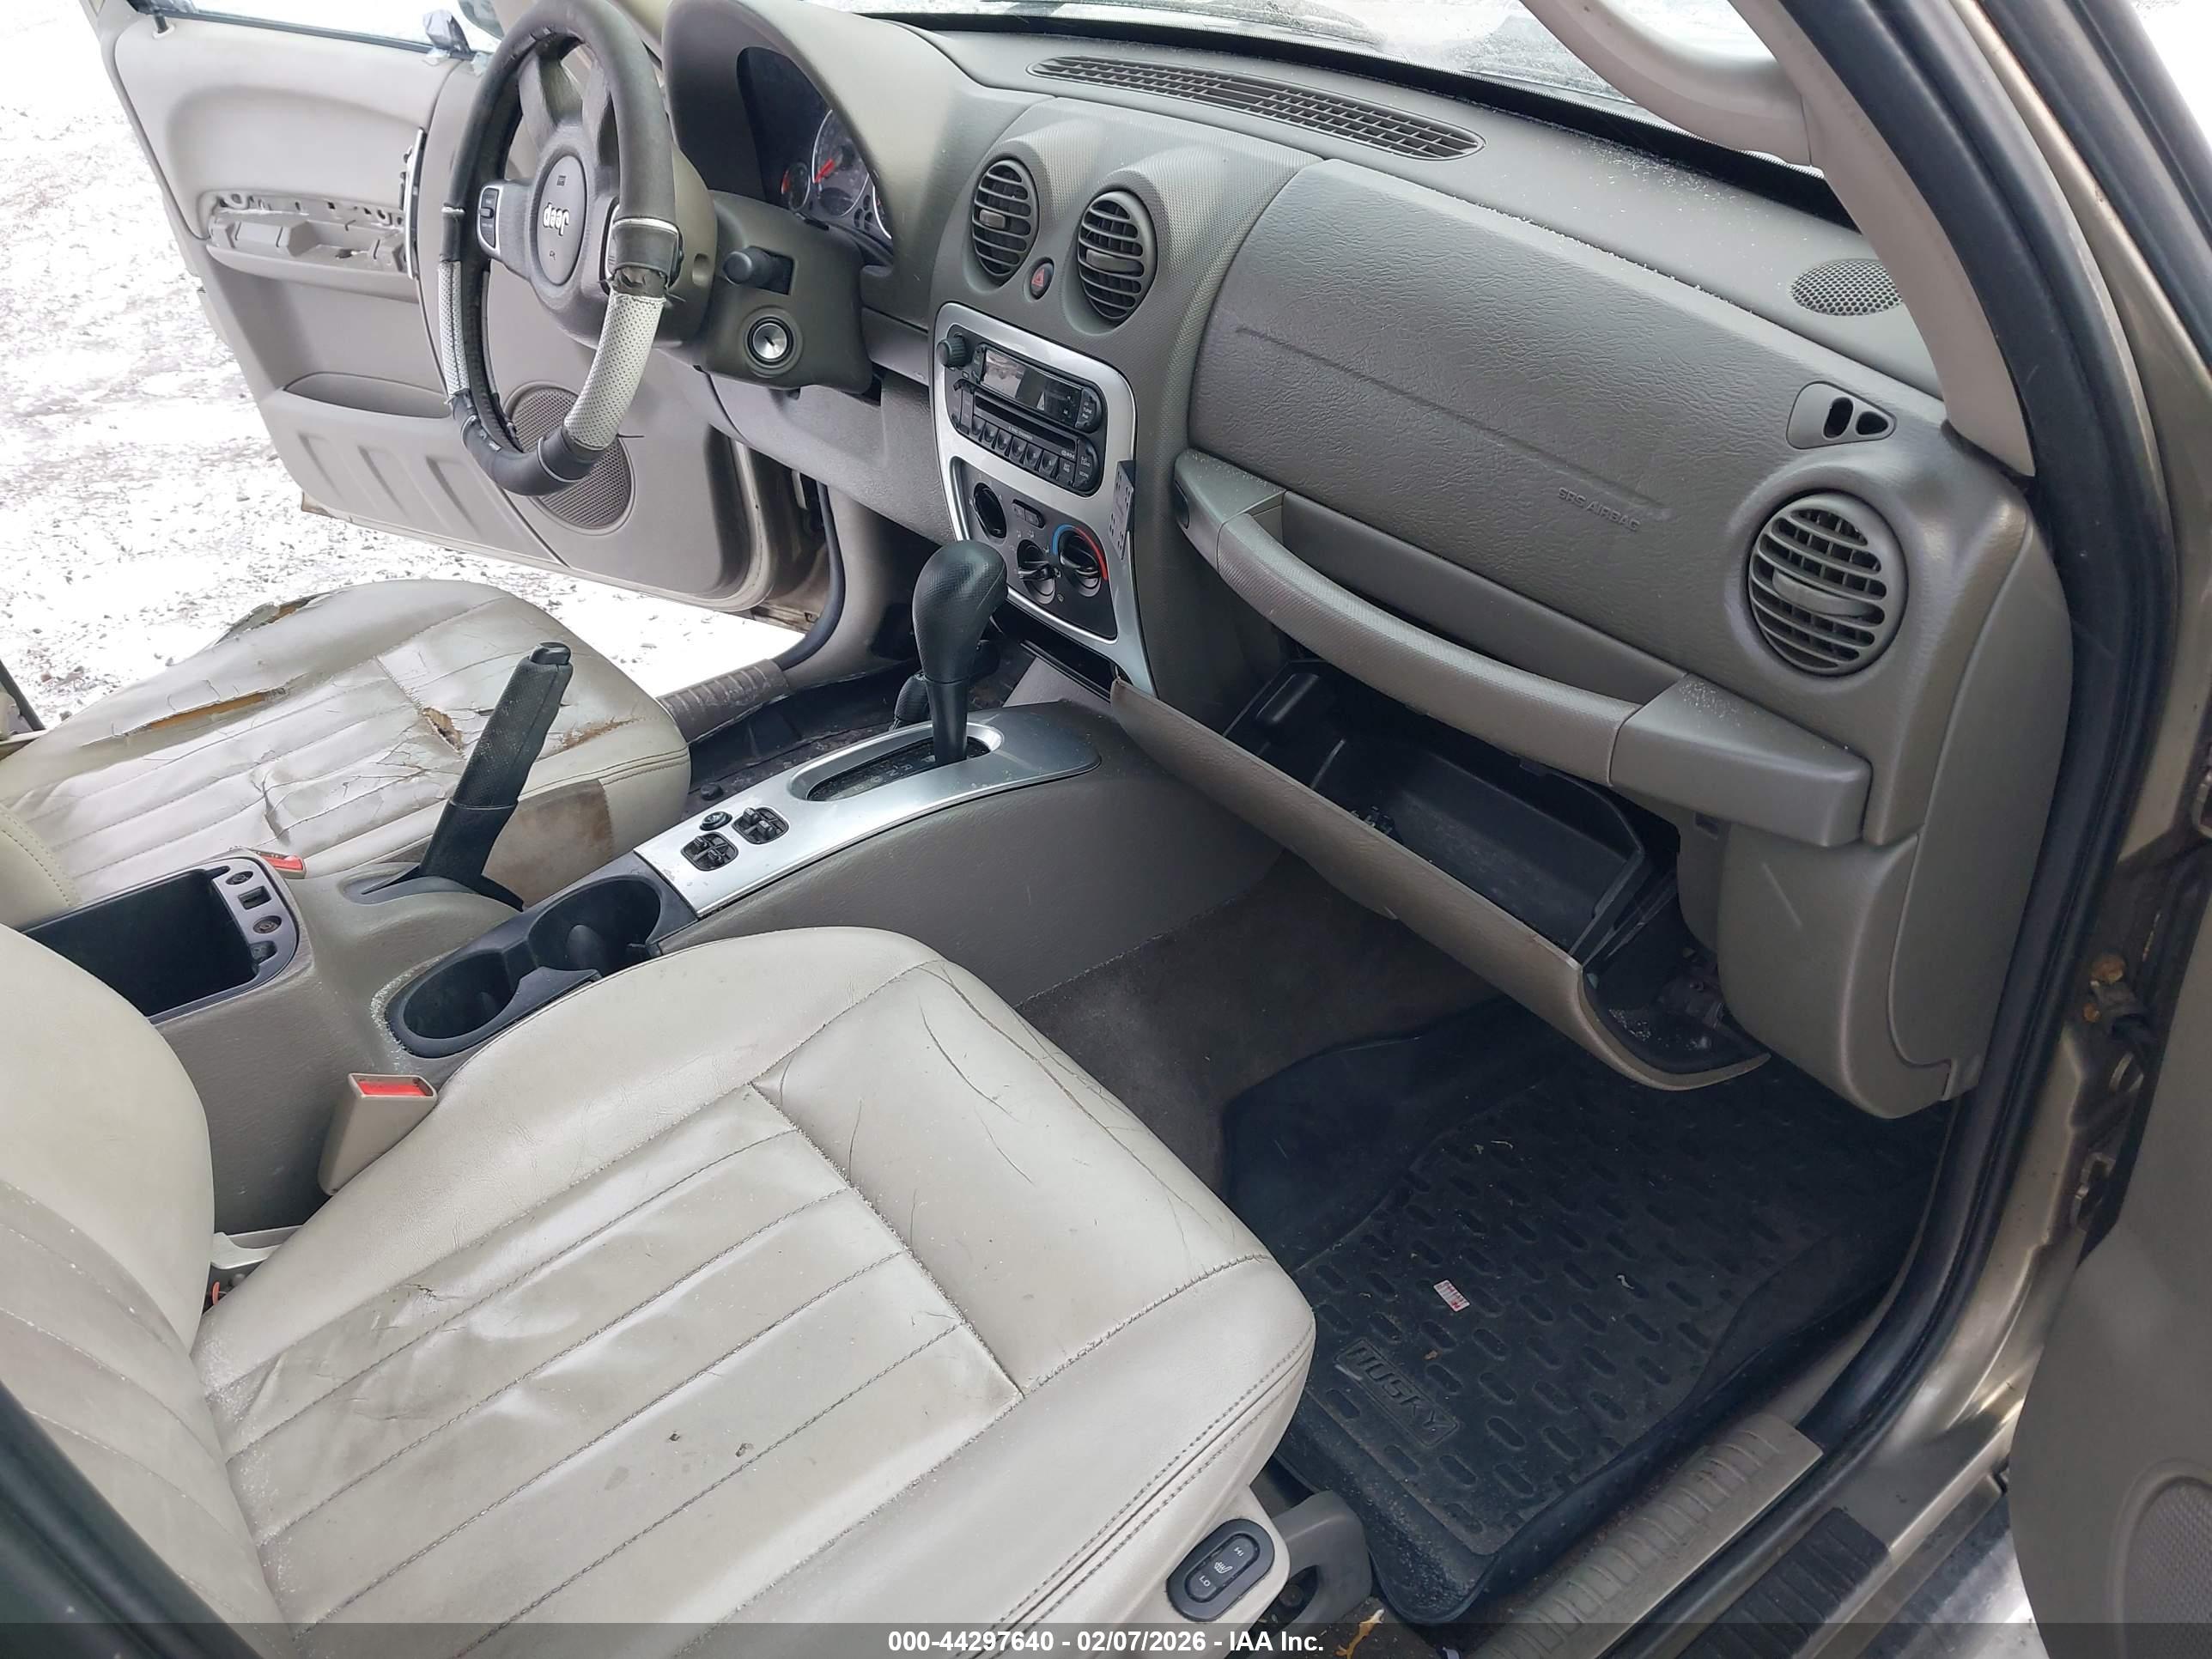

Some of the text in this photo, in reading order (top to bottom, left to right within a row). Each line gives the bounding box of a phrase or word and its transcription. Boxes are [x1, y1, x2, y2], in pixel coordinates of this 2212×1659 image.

[543, 203, 569, 236] Jeep
[1559, 487, 1642, 532] SRS AIRBAG
[1346, 1346, 1453, 1430] HUSKY
[1199, 1575, 1212, 1587] LO
